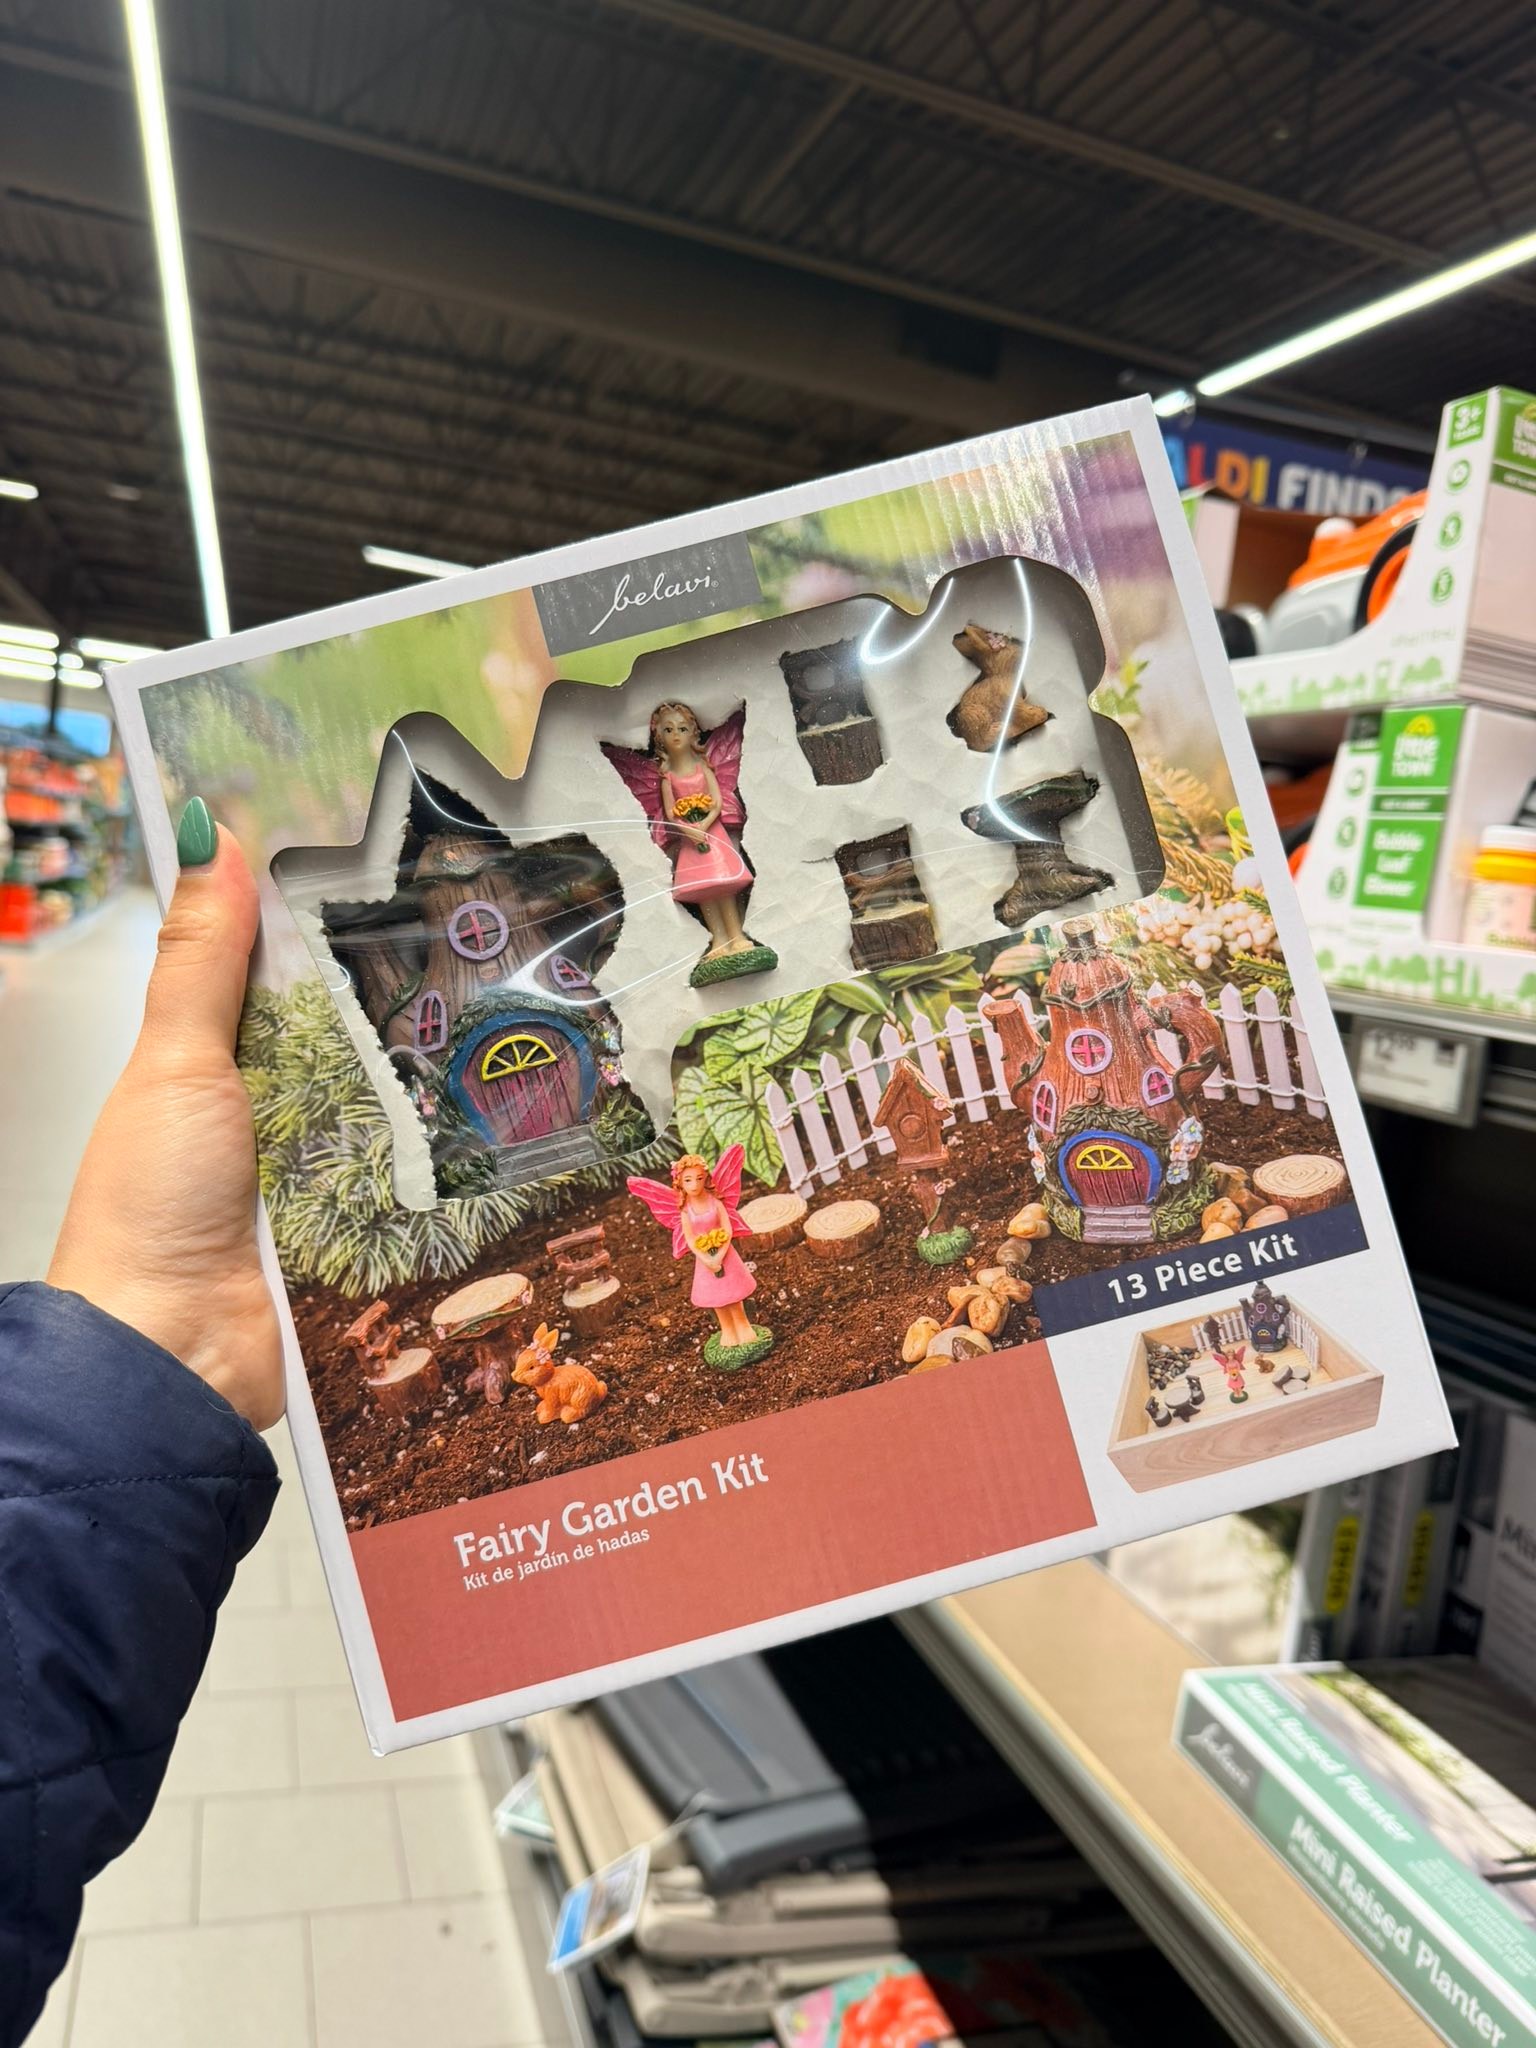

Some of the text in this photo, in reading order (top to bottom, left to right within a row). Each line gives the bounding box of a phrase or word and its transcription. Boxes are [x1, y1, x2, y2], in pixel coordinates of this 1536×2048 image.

[589, 566, 711, 635] belavi
[1107, 1232, 1299, 1304] 13 Piece Kit
[453, 1452, 769, 1568] Fairy Garden Kit
[463, 1527, 651, 1591] Kit de jardín de hadas
[1289, 1814, 1340, 1878] Mini
[1338, 1861, 1414, 1956] Raised
[1415, 1939, 1507, 2048] Planter
